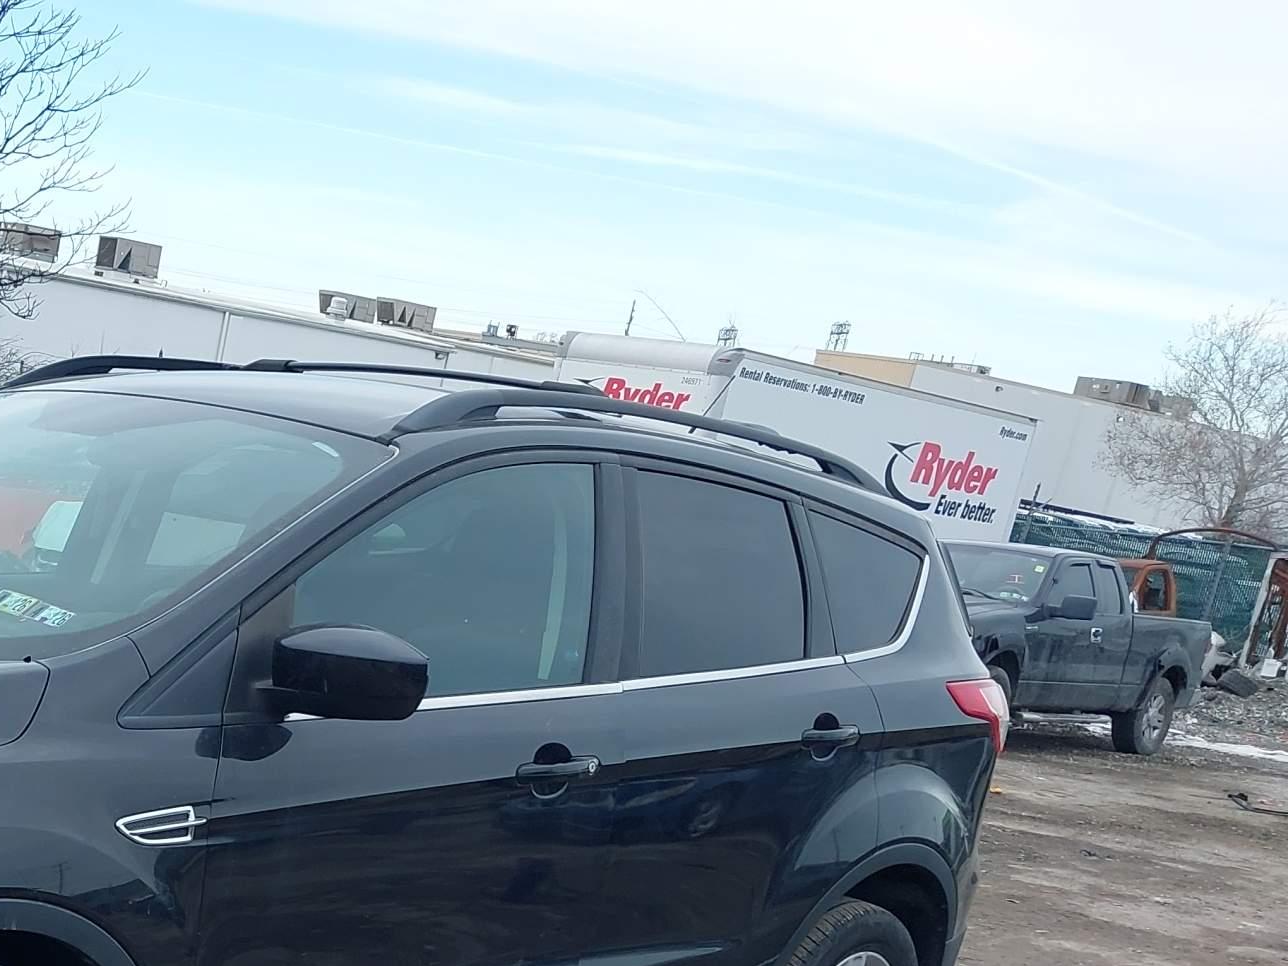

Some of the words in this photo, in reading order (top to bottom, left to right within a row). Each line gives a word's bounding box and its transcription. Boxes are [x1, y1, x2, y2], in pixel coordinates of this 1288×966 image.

[603, 377, 692, 410] Ryder
[739, 367, 764, 382] Rental
[763, 372, 810, 393] Reservations:
[811, 383, 866, 405] 1-800-BY-RYDER
[999, 426, 1028, 441] Ryder.com
[910, 441, 998, 497] Ryder
[934, 494, 961, 520] Ever
[961, 499, 997, 524] better.
